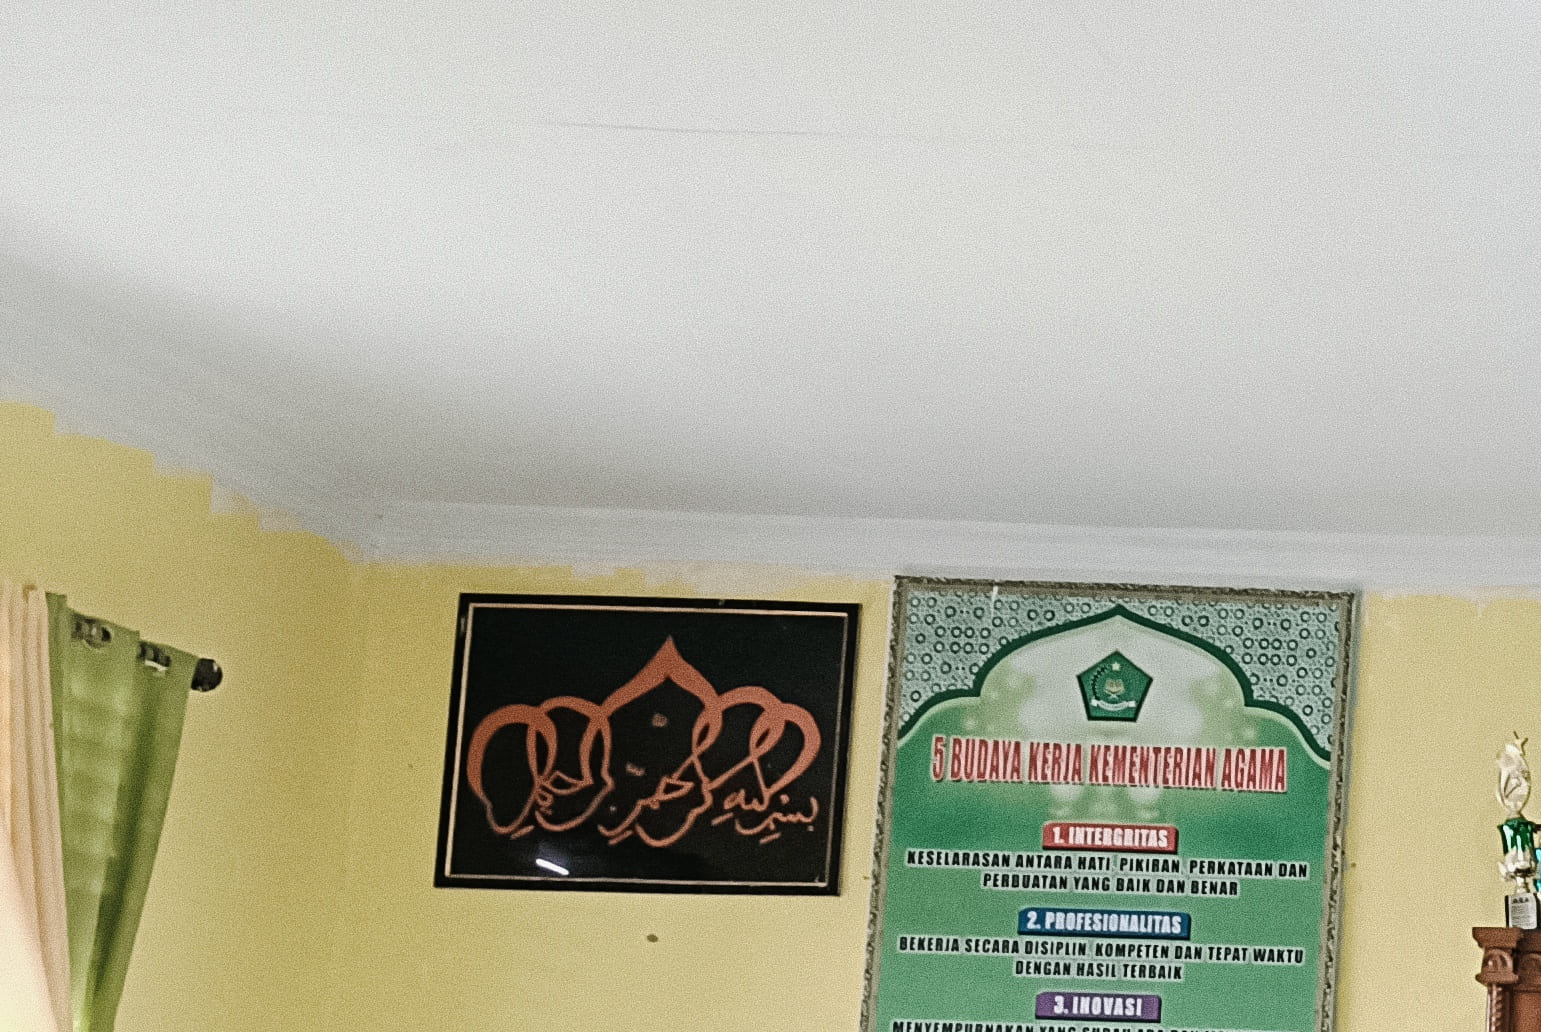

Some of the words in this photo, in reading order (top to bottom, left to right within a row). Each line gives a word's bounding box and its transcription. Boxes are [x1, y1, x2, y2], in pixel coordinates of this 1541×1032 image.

[932, 736, 945, 782] 5
[950, 738, 1022, 783] BUDAYA
[1028, 741, 1083, 784] KERJA
[1088, 743, 1217, 789] KEMENTERIAN
[1221, 747, 1287, 792] AGAMA
[1053, 826, 1065, 844] 1.
[1068, 826, 1168, 848] INTERGRITAS
[907, 850, 1011, 868] KESELARASAN
[1015, 854, 1073, 870] ANTARA
[1189, 860, 1273, 876] PERKATAAN
[1278, 862, 1308, 878] DAN
[983, 873, 1068, 890] PERBUATAN
[1074, 876, 1111, 892] YANG
[1116, 877, 1151, 893] BAIK
[1156, 879, 1185, 894] DAN
[1191, 880, 1239, 896] BENAR
[1027, 911, 1041, 930] 2.
[1044, 911, 1182, 934] PROFESIONALITAS
[899, 936, 960, 952] BEKERJA
[965, 939, 1019, 954] SECARA
[1095, 942, 1169, 959] KOMPETEN
[1174, 945, 1202, 960] DAN
[1208, 946, 1249, 962] TEPAT
[1253, 948, 1304, 964] WAKTU
[1015, 960, 1071, 976] DENGAN
[1076, 962, 1117, 978] HASIL
[1123, 963, 1182, 980] TERBAIK
[1053, 995, 1069, 1015] 3.
[1072, 996, 1143, 1017] INOVASI
